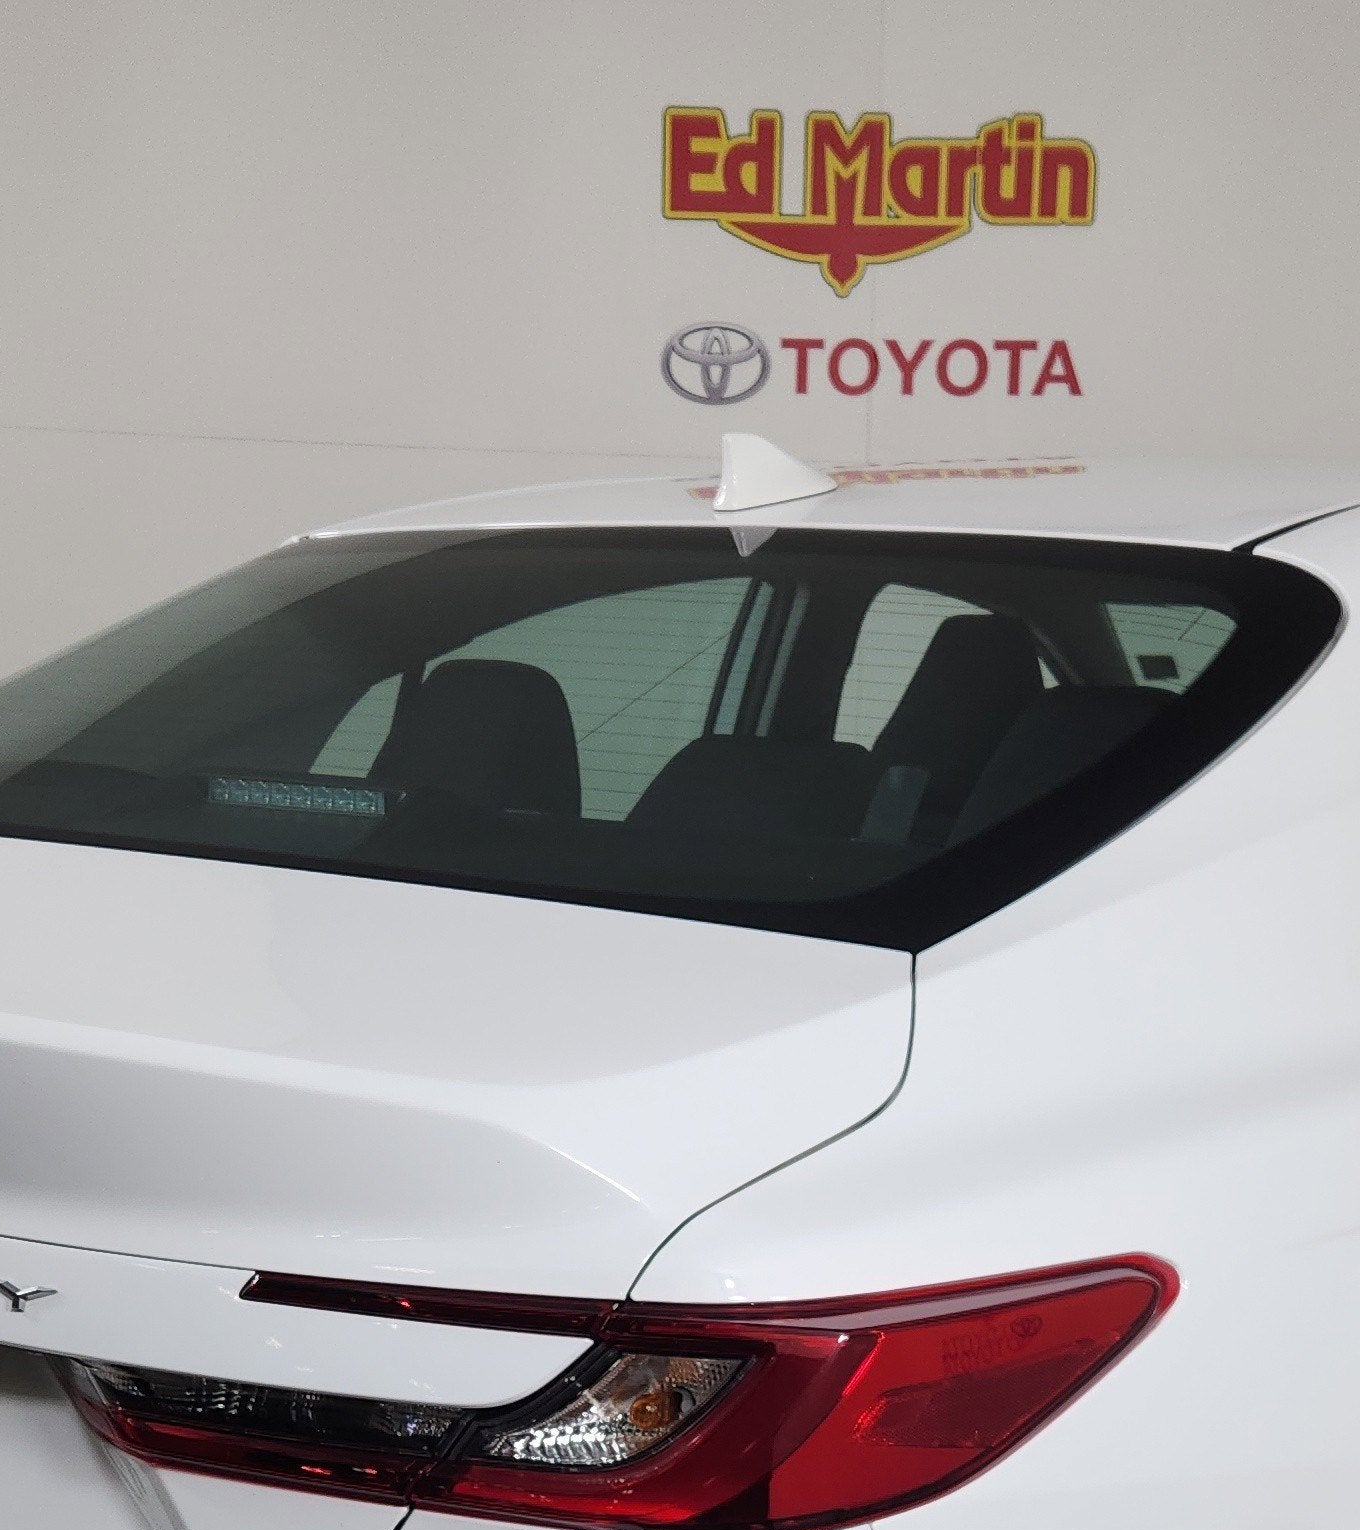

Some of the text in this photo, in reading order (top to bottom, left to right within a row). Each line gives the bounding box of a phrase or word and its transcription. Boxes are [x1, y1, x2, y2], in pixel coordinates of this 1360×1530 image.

[663, 106, 1096, 227] Ed Martin
[781, 337, 1084, 398] TOYOTA
